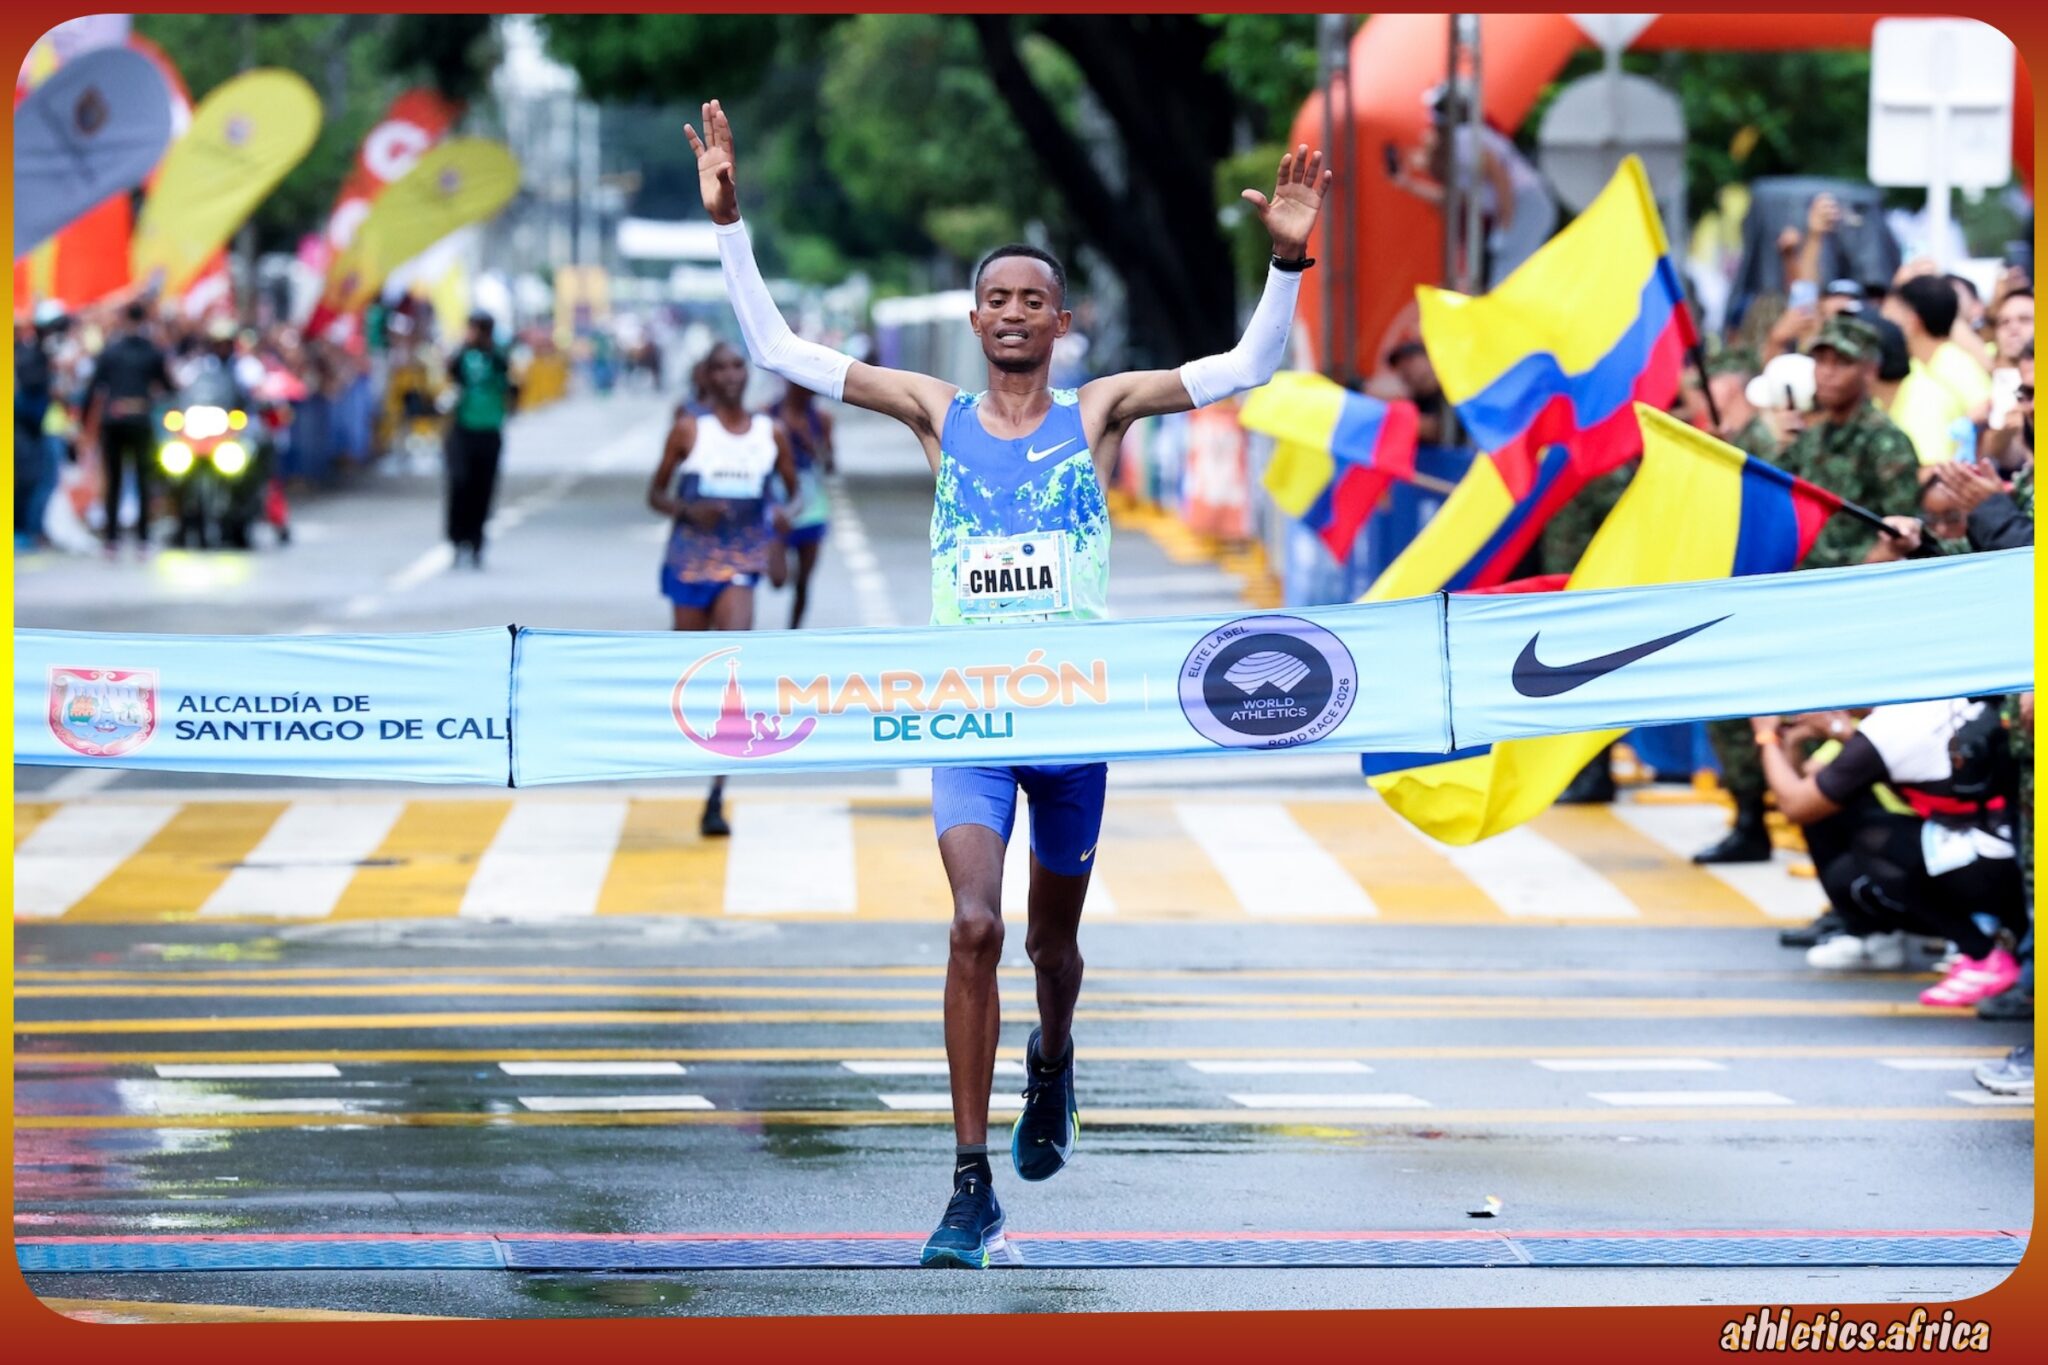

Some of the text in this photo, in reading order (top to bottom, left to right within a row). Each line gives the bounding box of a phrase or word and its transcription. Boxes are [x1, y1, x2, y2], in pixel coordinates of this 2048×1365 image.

[970, 566, 1053, 594] CHALLA
[1188, 626, 1249, 678] ELITE LABEL
[777, 649, 1108, 715] MARATÓN
[177, 691, 370, 713] ALCALDÍA DE
[1230, 707, 1308, 721] ATHLETICS
[1243, 697, 1295, 709] WORLD
[1268, 678, 1350, 746] ROAD RACE 2026
[175, 720, 364, 741] SANTIAGO
[379, 720, 424, 740] DE
[873, 712, 1014, 741] DE CALI
